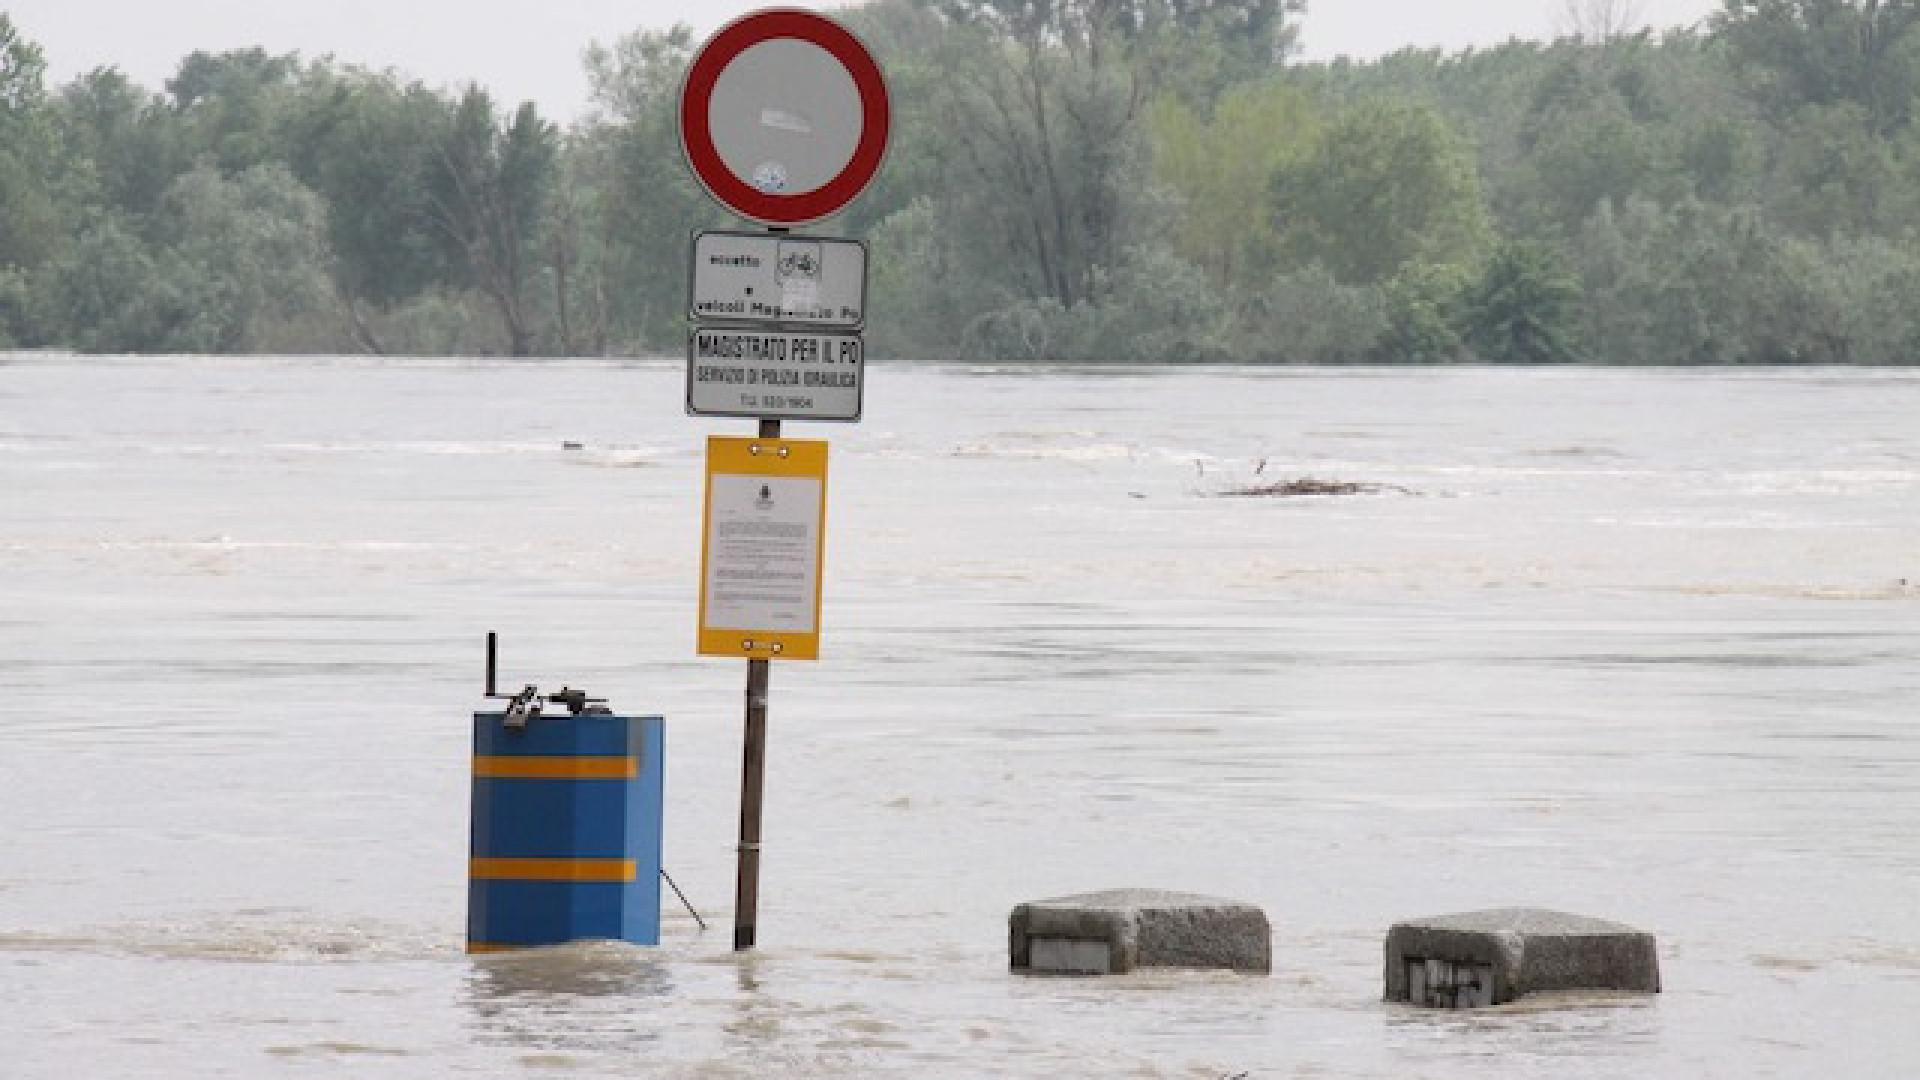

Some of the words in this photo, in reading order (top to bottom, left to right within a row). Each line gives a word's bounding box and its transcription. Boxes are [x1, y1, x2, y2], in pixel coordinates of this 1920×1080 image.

[697, 300, 744, 312] veicoli
[699, 336, 786, 360] MAGISTRATO
[792, 338, 817, 362] PER
[822, 340, 834, 363] IL
[840, 341, 858, 363] PO
[697, 366, 744, 384] SERVIZIO
[747, 368, 758, 384] DI
[762, 369, 798, 387] POLIZIA
[803, 371, 856, 388] IDRAULICA
